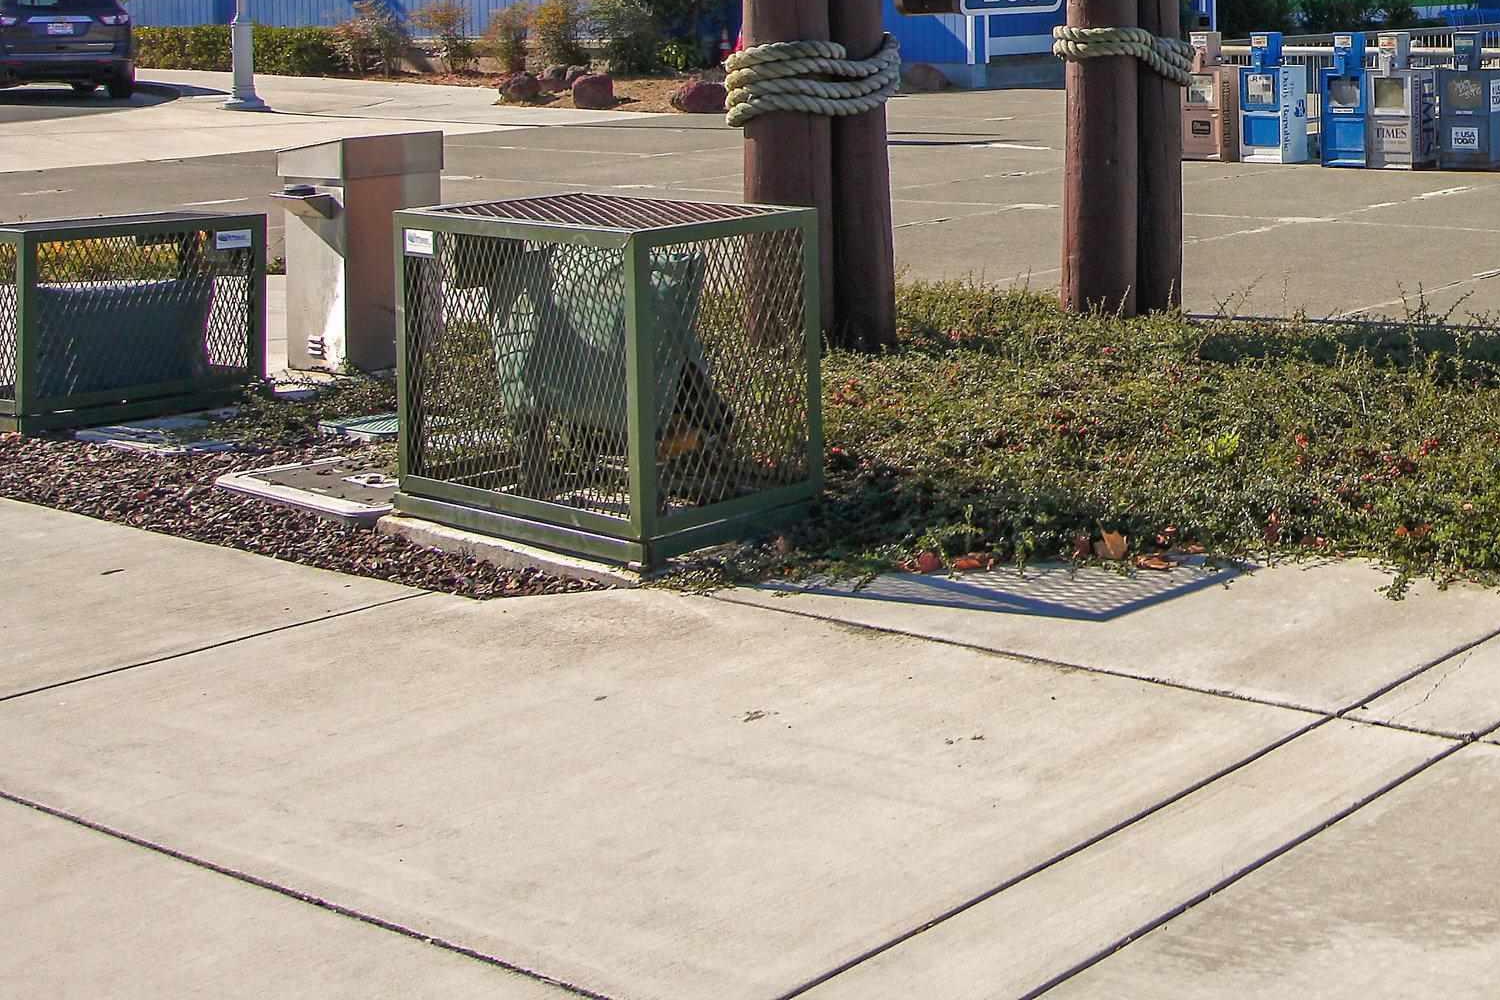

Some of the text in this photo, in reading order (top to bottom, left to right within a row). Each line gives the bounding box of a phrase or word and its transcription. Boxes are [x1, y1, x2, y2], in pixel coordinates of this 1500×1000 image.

[1282, 104, 1292, 152] Republic
[1375, 128, 1407, 139] TIMES
[1460, 131, 1475, 139] USA
